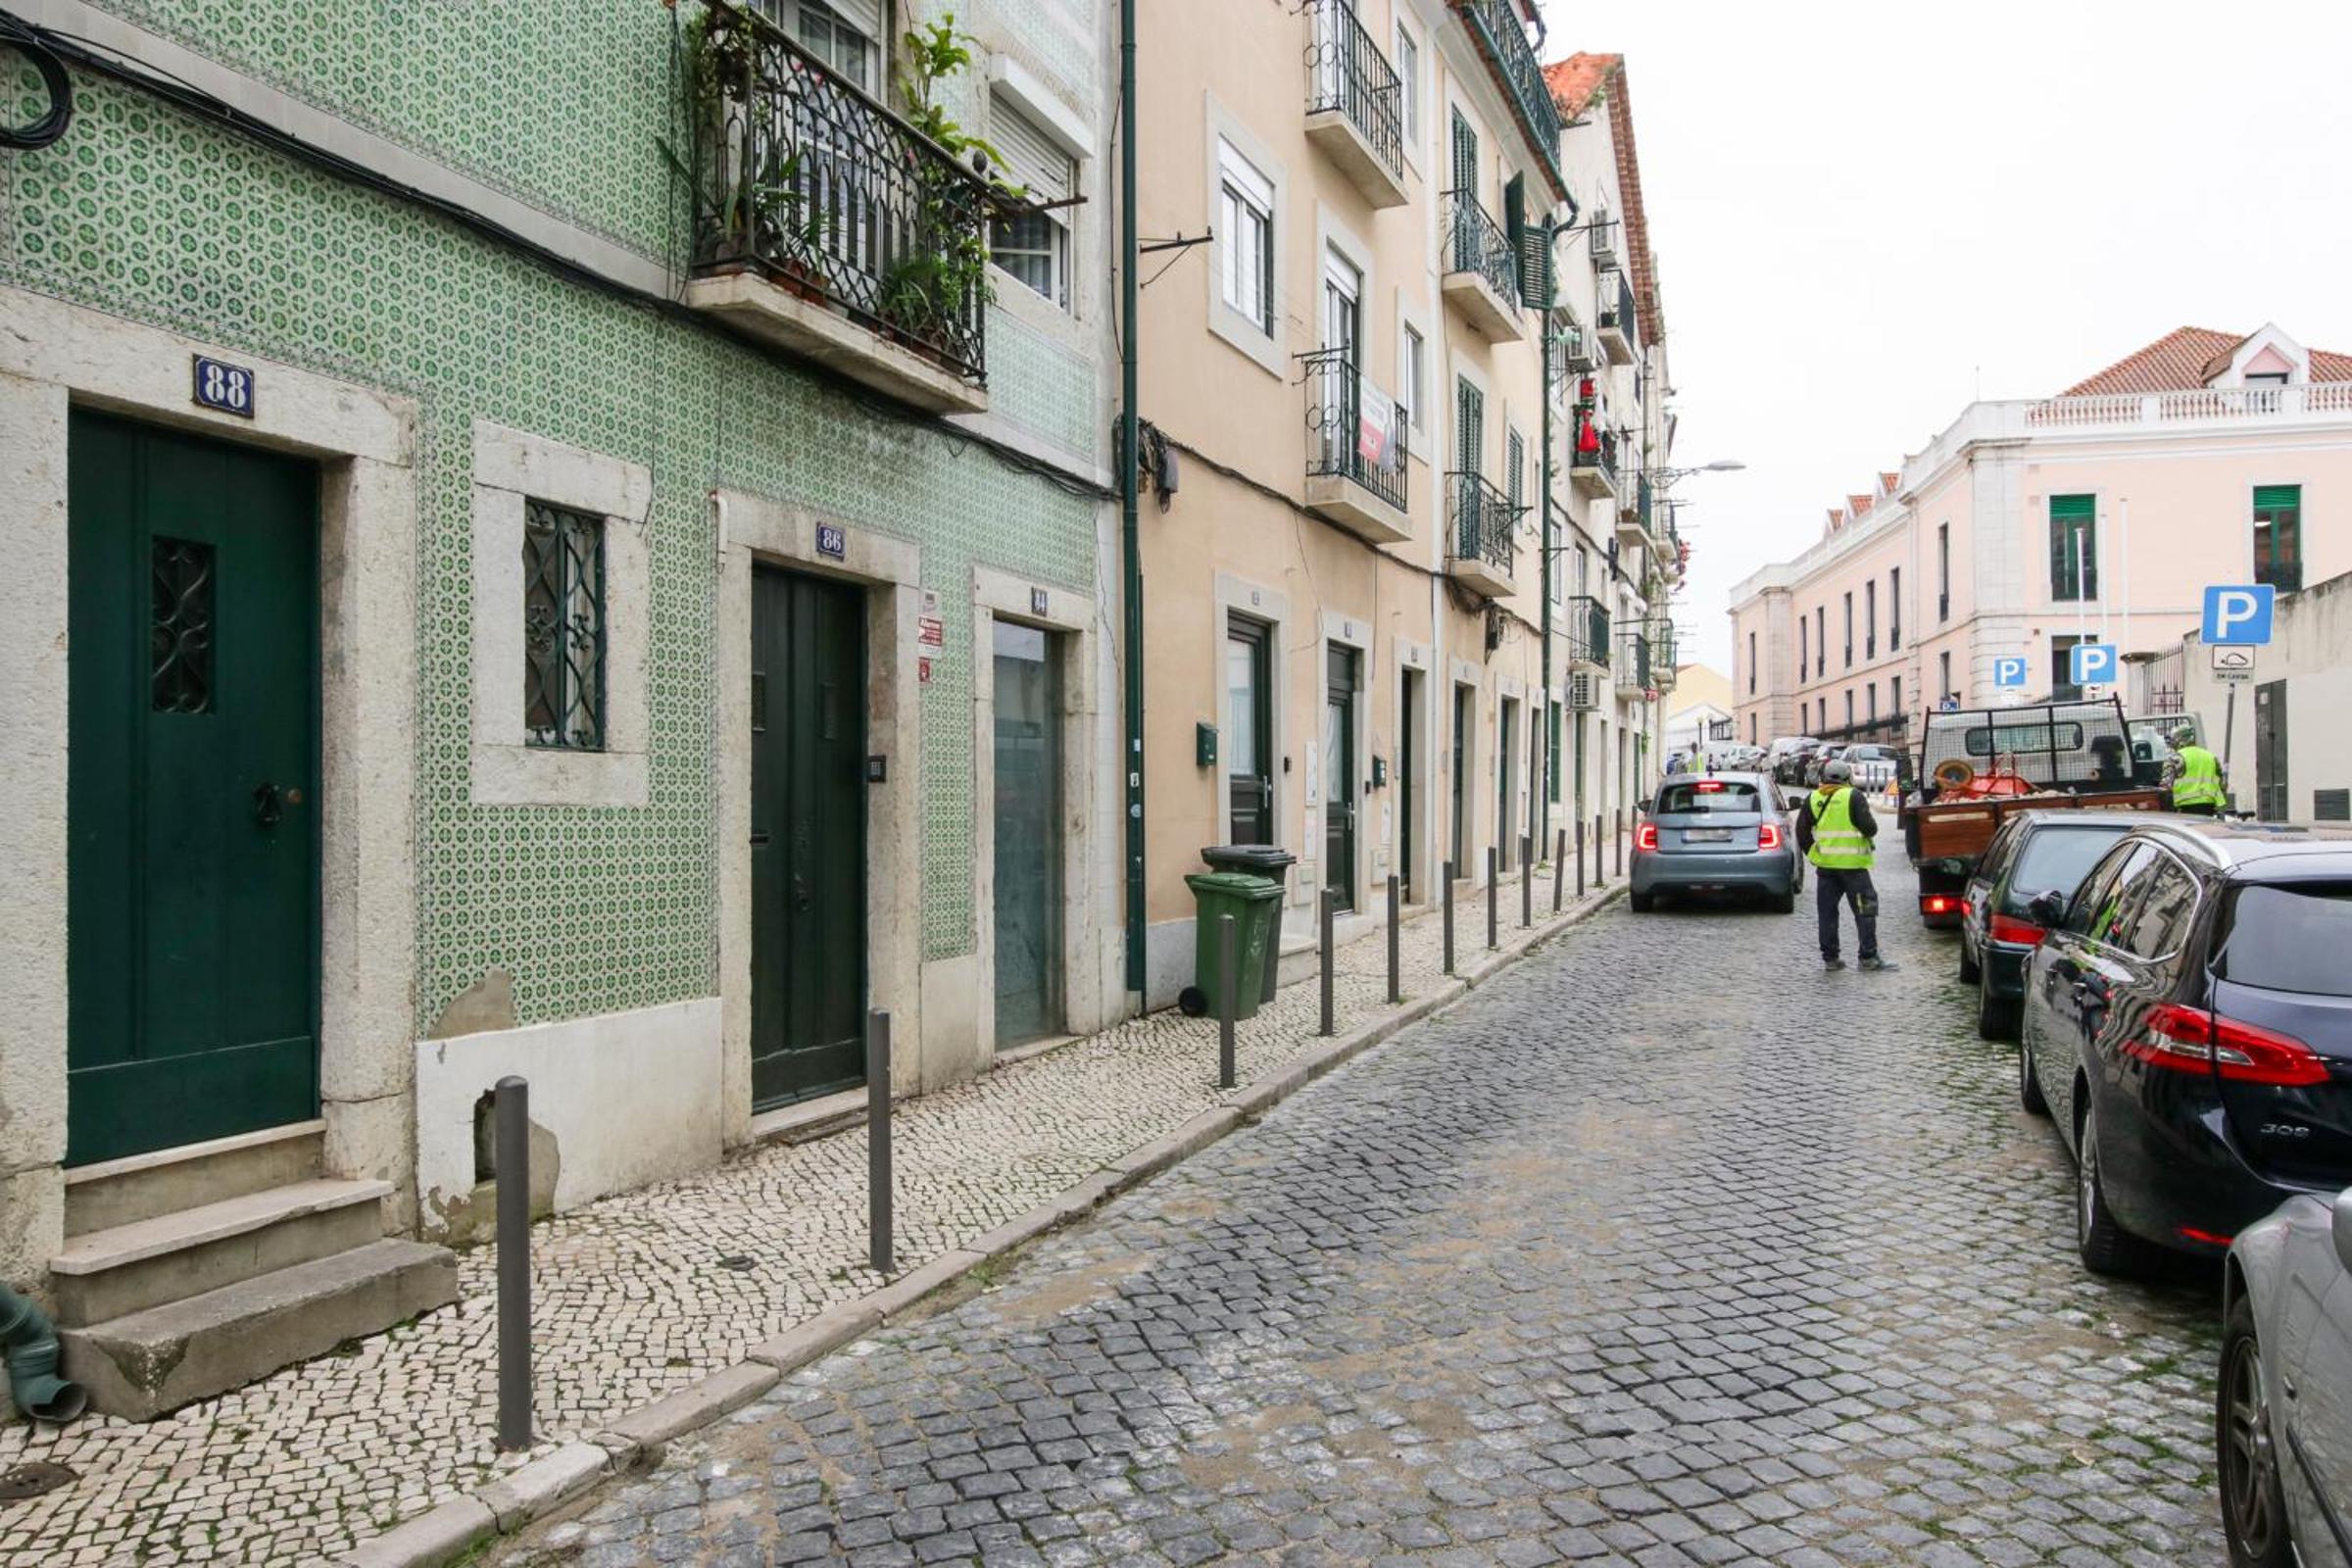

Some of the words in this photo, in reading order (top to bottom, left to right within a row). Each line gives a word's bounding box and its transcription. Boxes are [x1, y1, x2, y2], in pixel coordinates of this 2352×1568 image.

[205, 365, 246, 408] 88
[823, 529, 842, 551] 86
[2217, 592, 2258, 639] P
[2000, 661, 2020, 685] P
[2081, 649, 2107, 681] P
